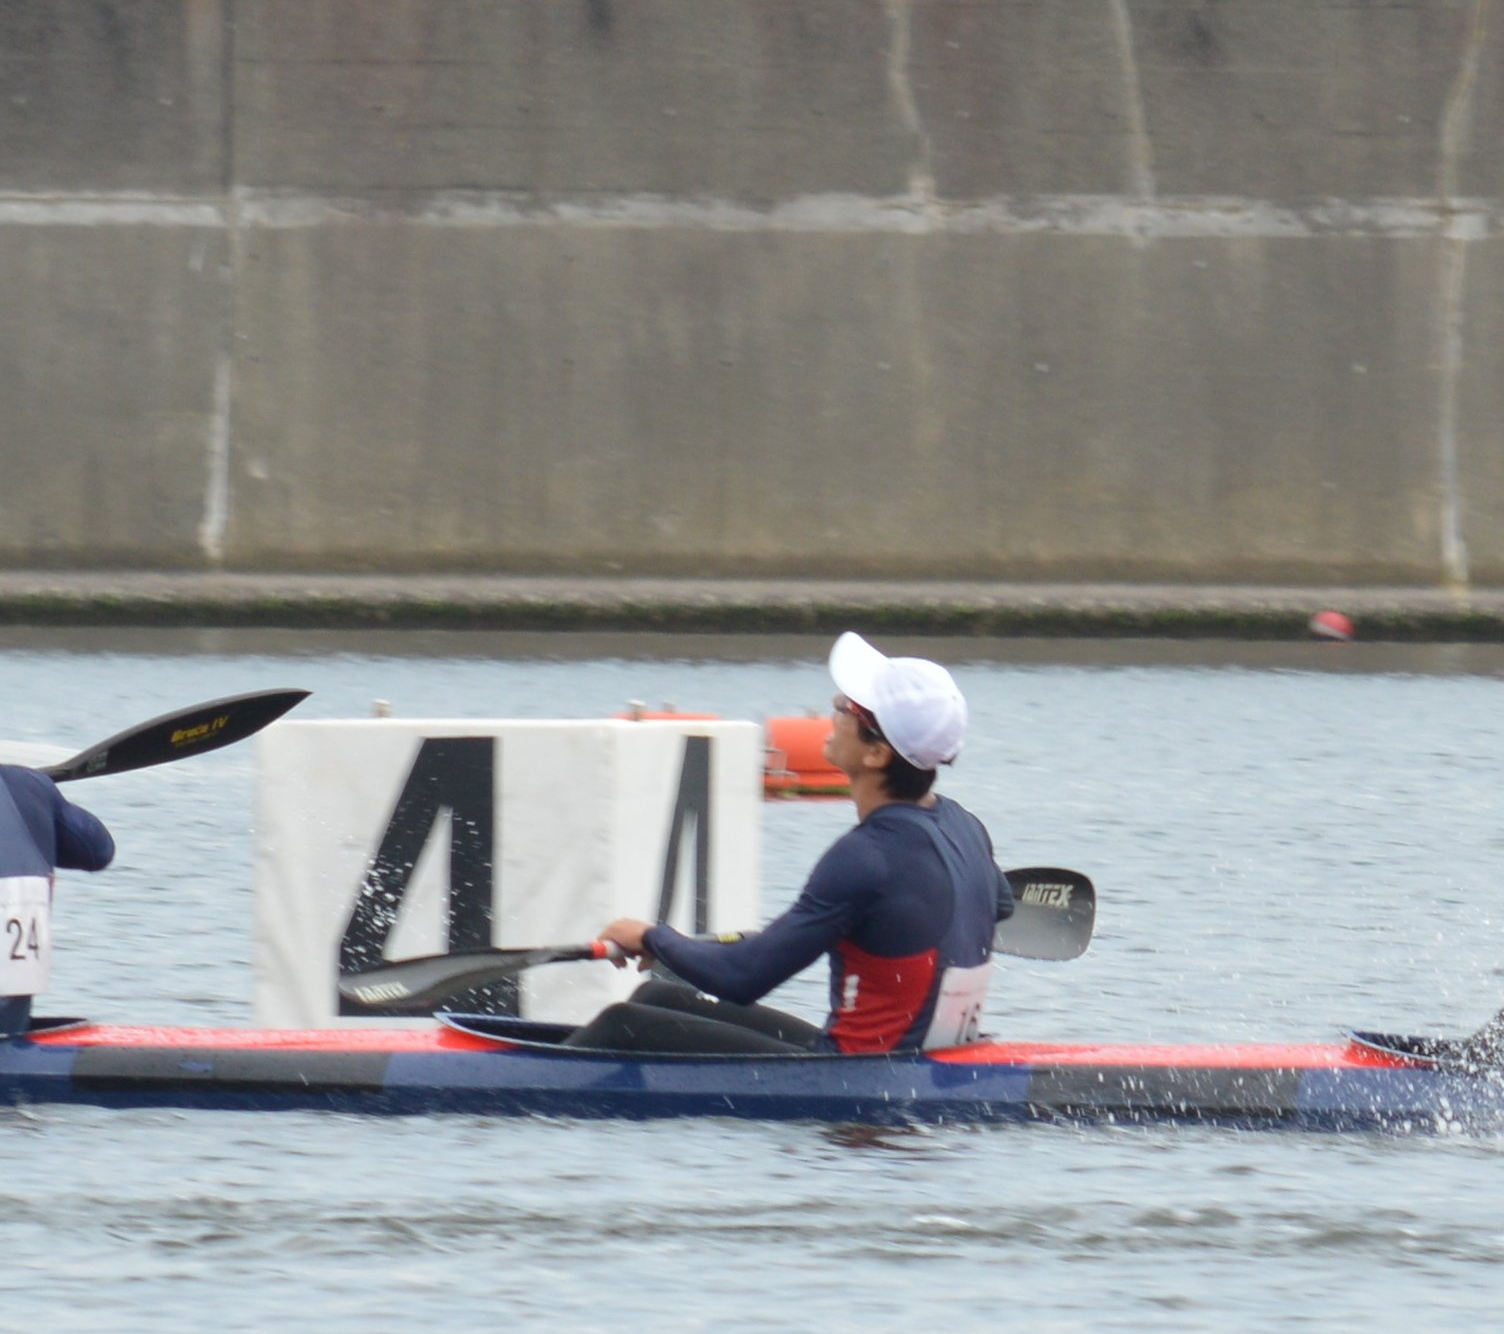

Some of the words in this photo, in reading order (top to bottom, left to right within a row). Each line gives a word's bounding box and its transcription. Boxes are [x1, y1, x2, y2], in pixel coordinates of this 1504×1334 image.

[6, 917, 41, 961] 24
[338, 735, 522, 1019] 4
[650, 735, 714, 972] 4
